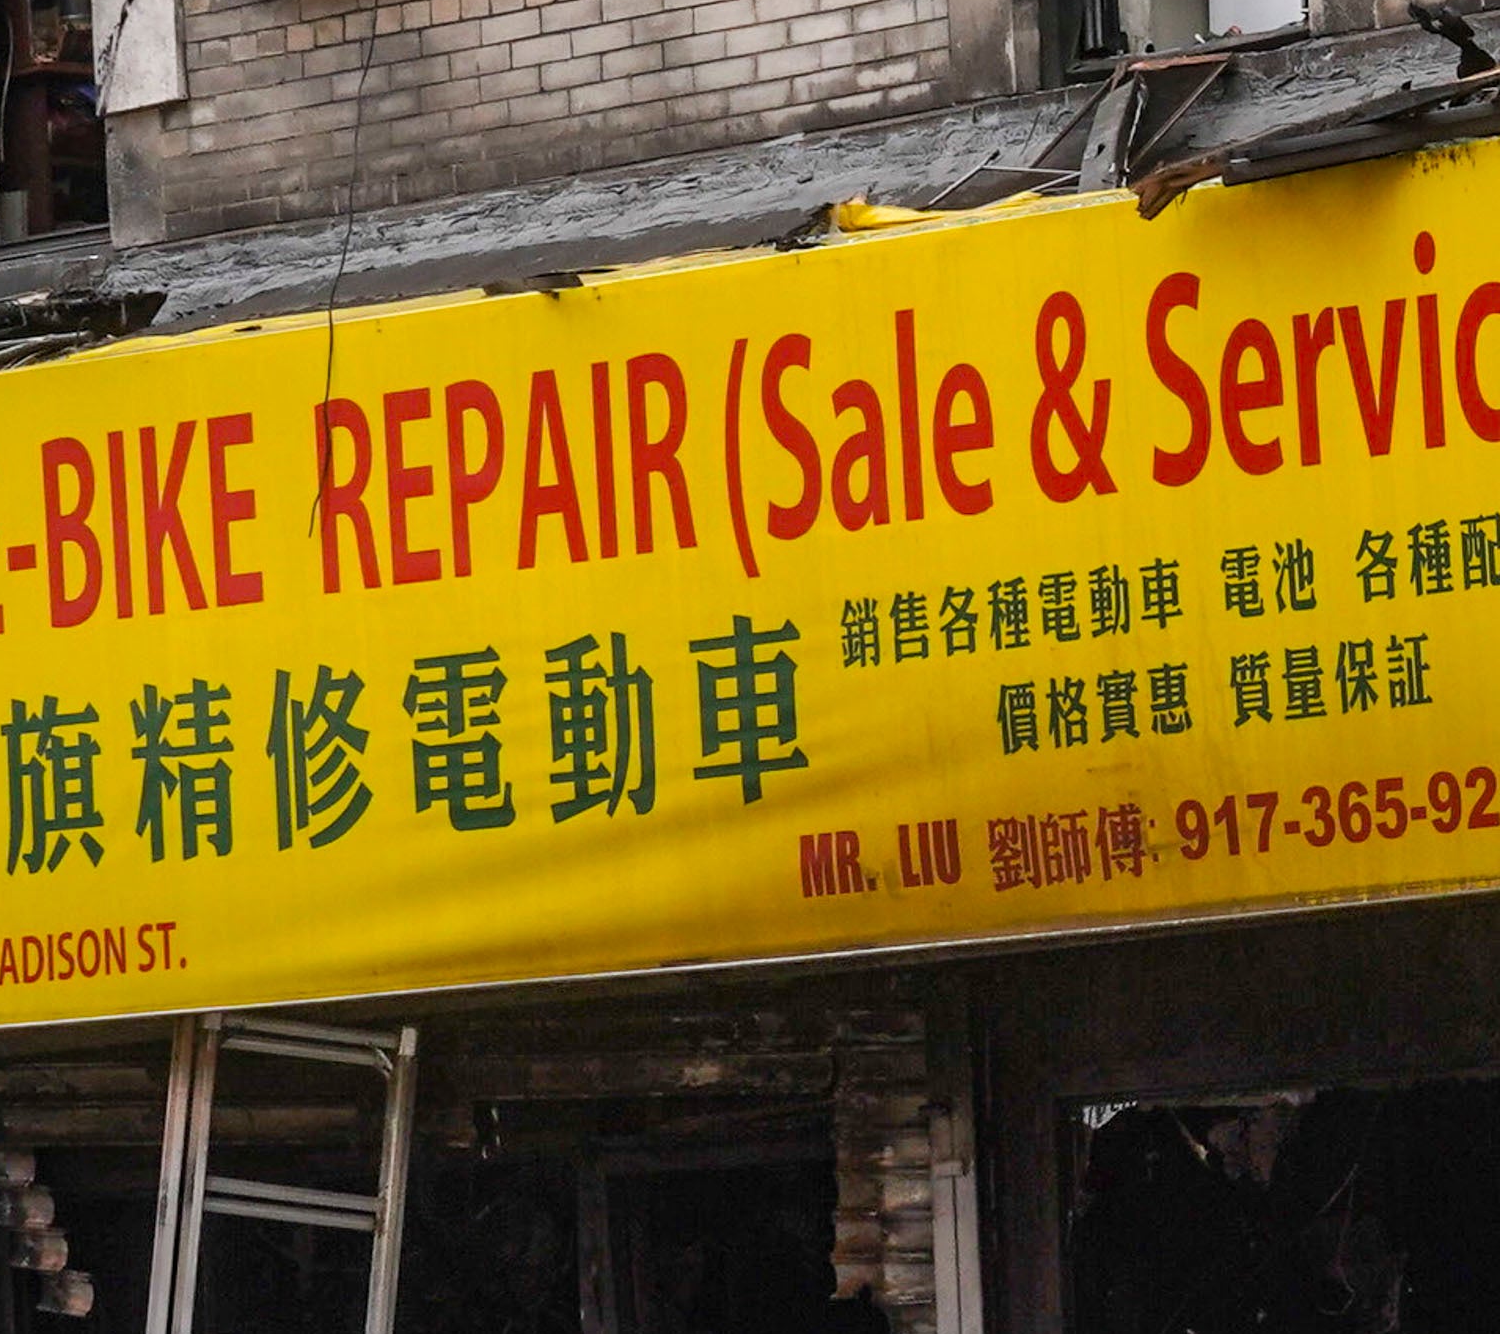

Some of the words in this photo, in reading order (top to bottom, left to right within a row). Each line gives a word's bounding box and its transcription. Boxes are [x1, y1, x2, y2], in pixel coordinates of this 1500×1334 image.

[313, 352, 698, 594] REPAIR
[724, 308, 995, 579] (Sale
[1030, 290, 1114, 504] &
[841, 558, 1183, 668] 銷售各種電動車
[1220, 538, 1318, 618] 電池
[996, 662, 1193, 756] 價格實惠
[799, 830, 877, 898] MR.
[898, 819, 961, 888] LIU
[136, 921, 187, 973] ST.
